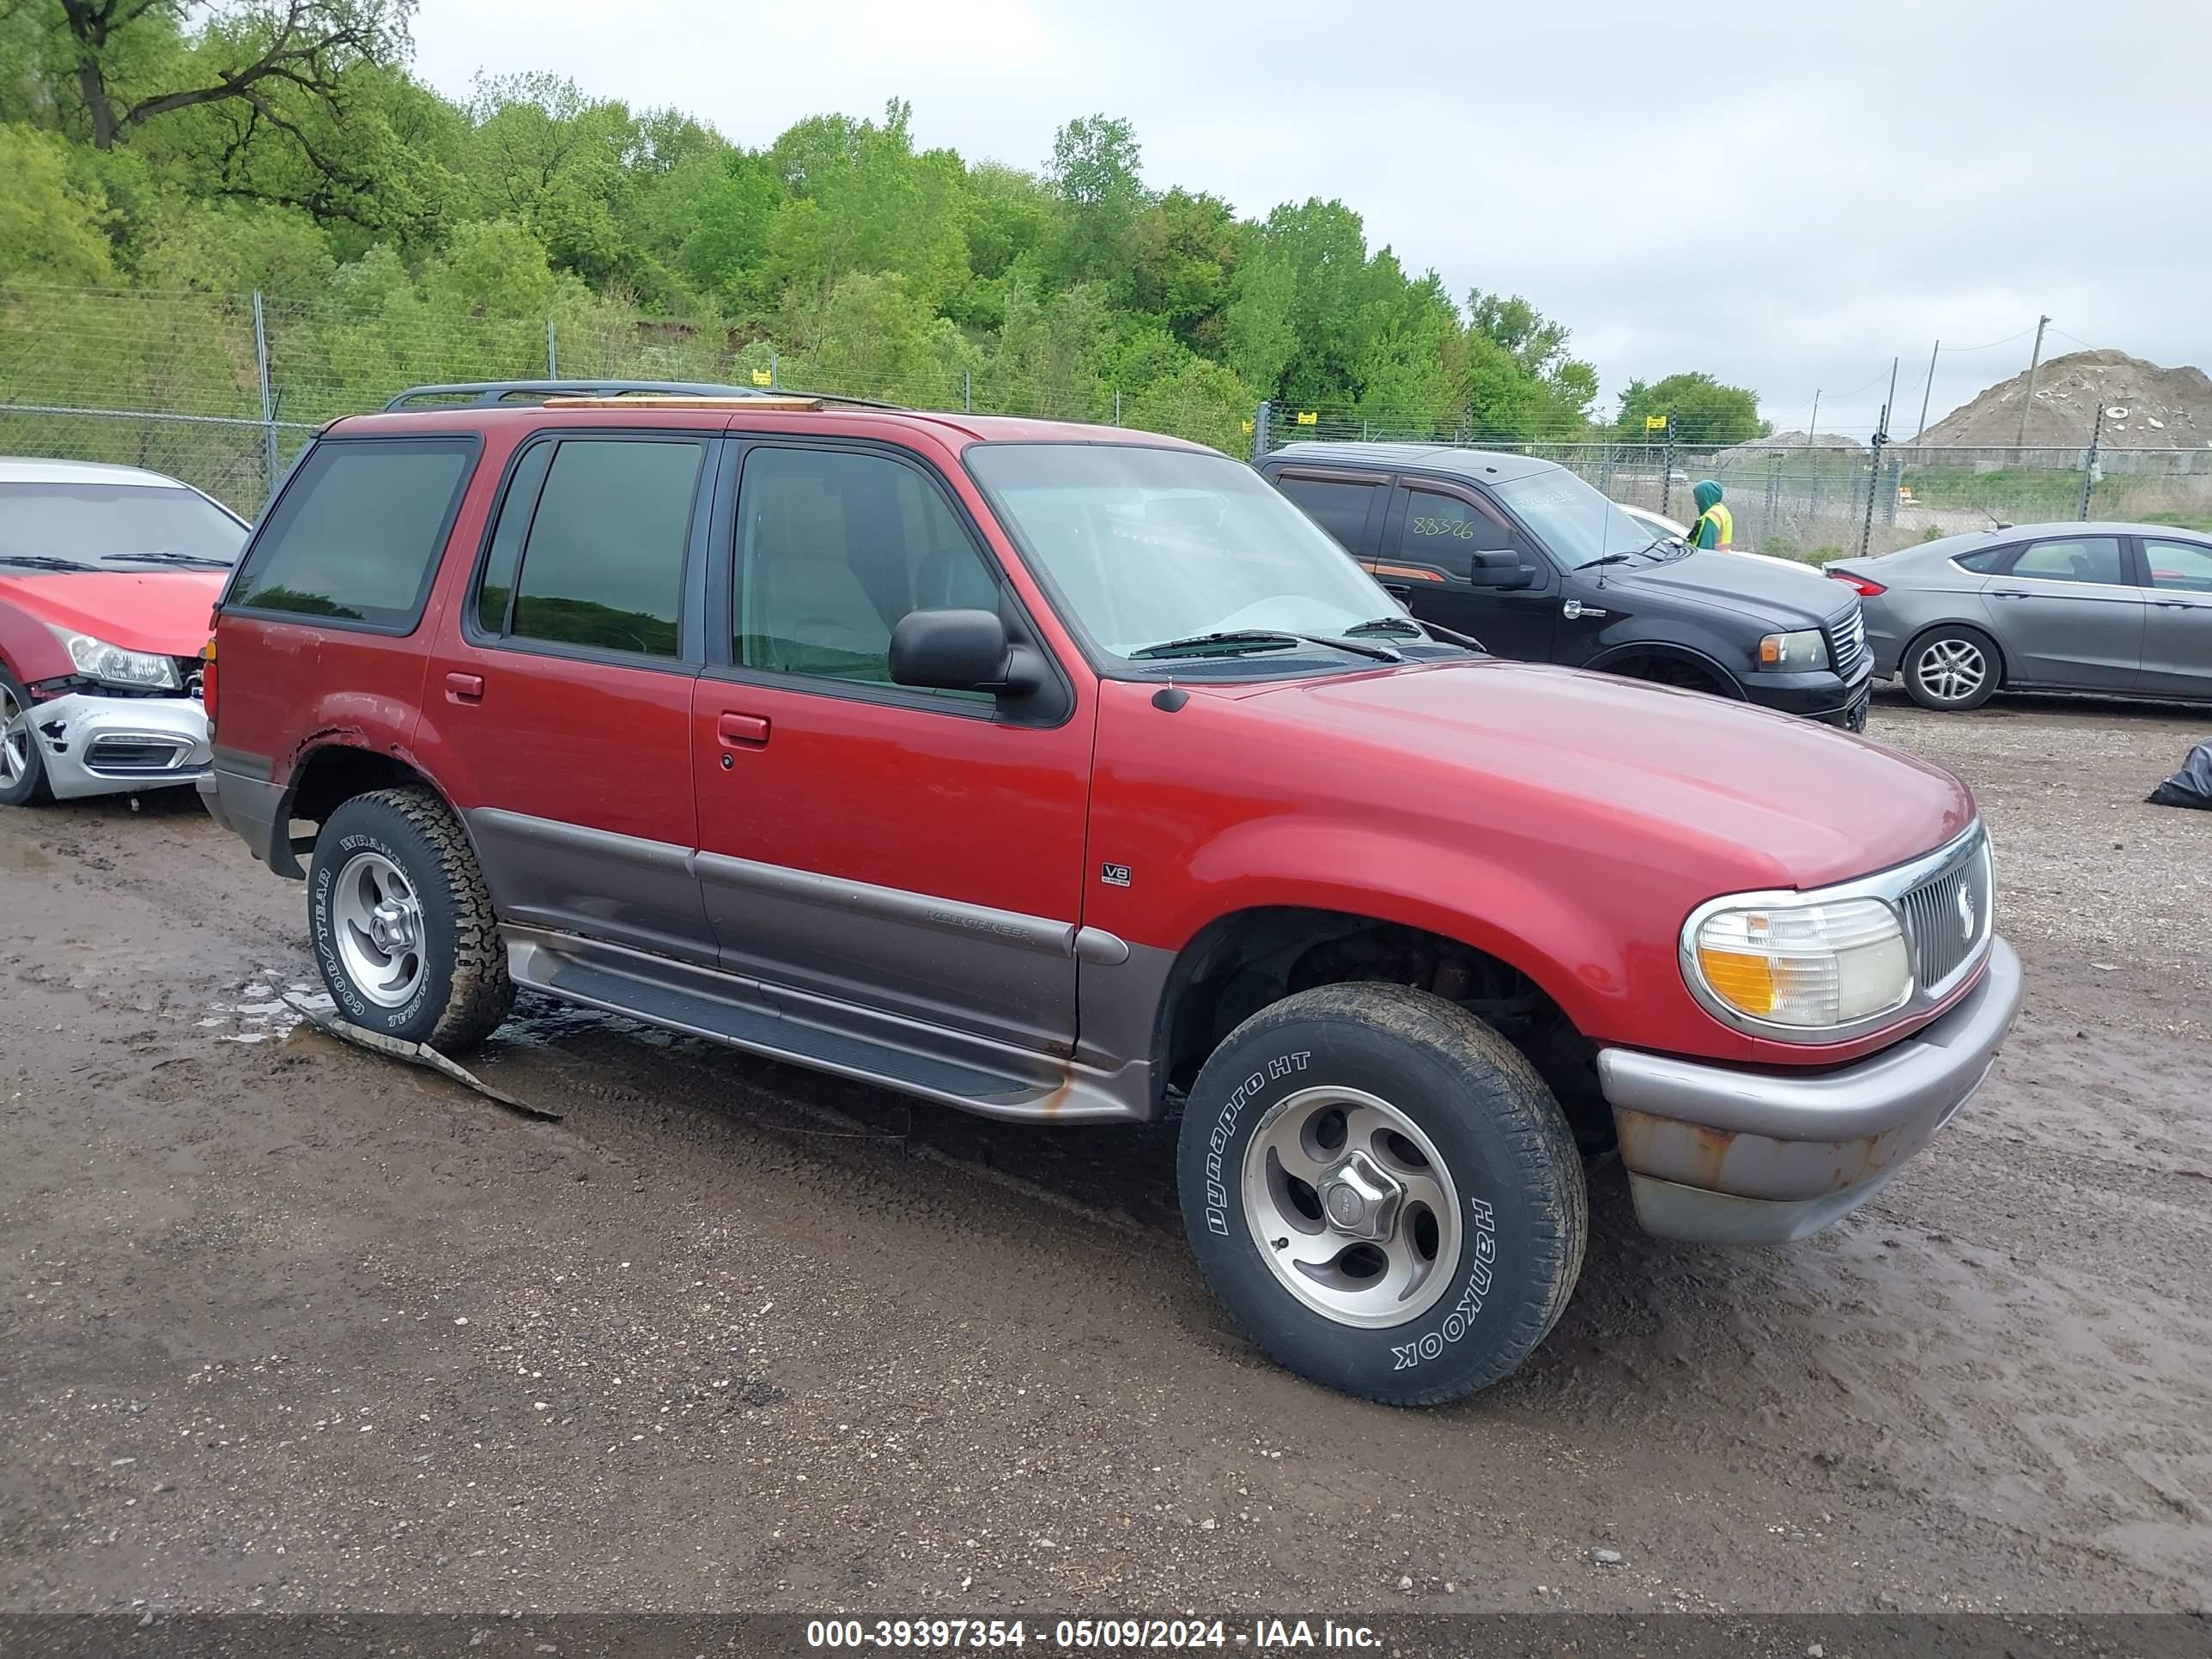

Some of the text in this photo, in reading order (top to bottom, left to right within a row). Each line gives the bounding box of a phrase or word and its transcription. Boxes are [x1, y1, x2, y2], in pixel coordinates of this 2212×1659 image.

[1413, 517, 1475, 539] 88326
[1104, 865, 1128, 879] V8
[927, 909, 1031, 940] MOUNTAINEER
[1206, 1051, 1311, 1237] Dynapro HT
